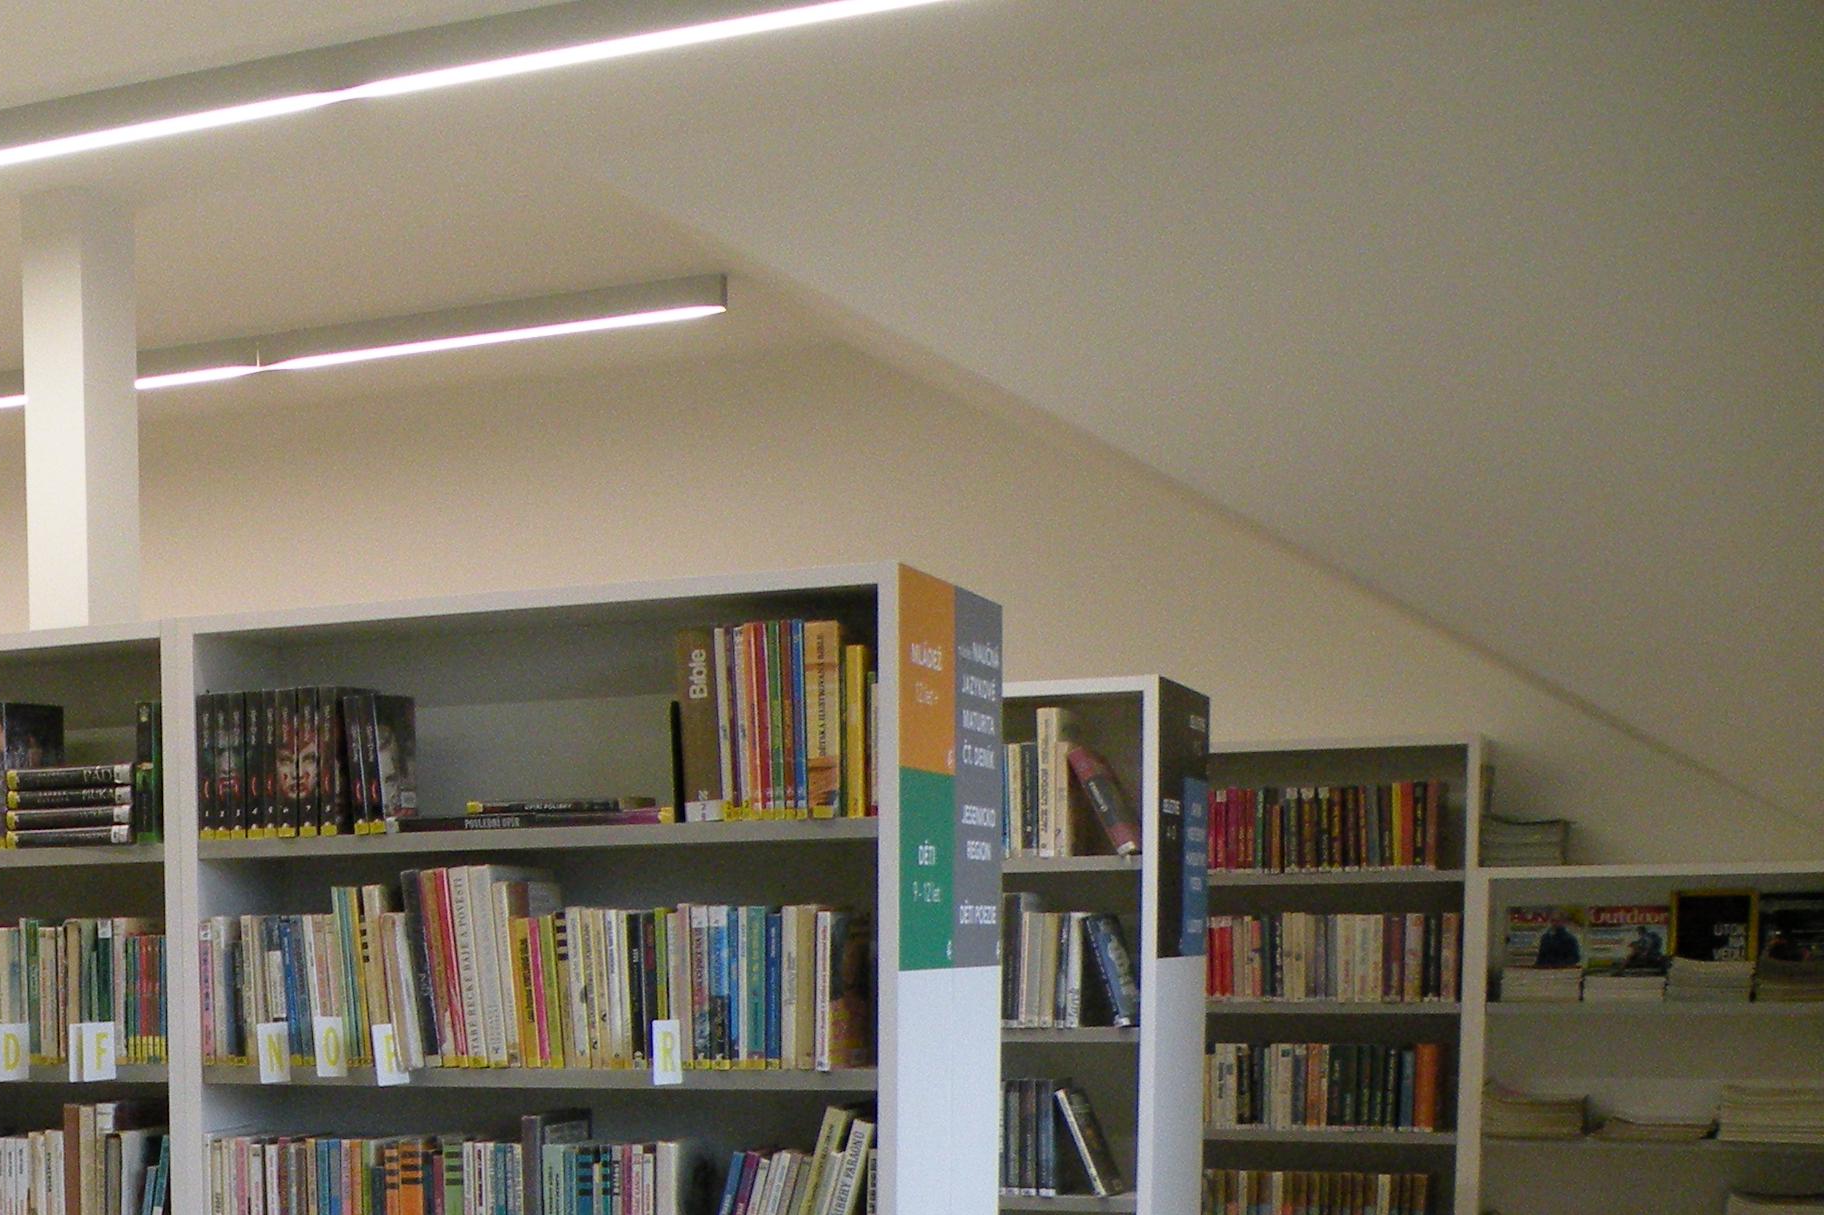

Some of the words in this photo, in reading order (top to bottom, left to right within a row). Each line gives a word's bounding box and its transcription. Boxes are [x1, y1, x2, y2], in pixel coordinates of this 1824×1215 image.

[689, 648, 708, 700] Bible
[918, 840, 936, 866] DĚTI
[1588, 905, 1668, 924] Outdoor
[3, 1033, 20, 1072] D
[95, 1032, 109, 1071] F
[266, 1033, 284, 1073] N
[659, 1031, 674, 1072] R
